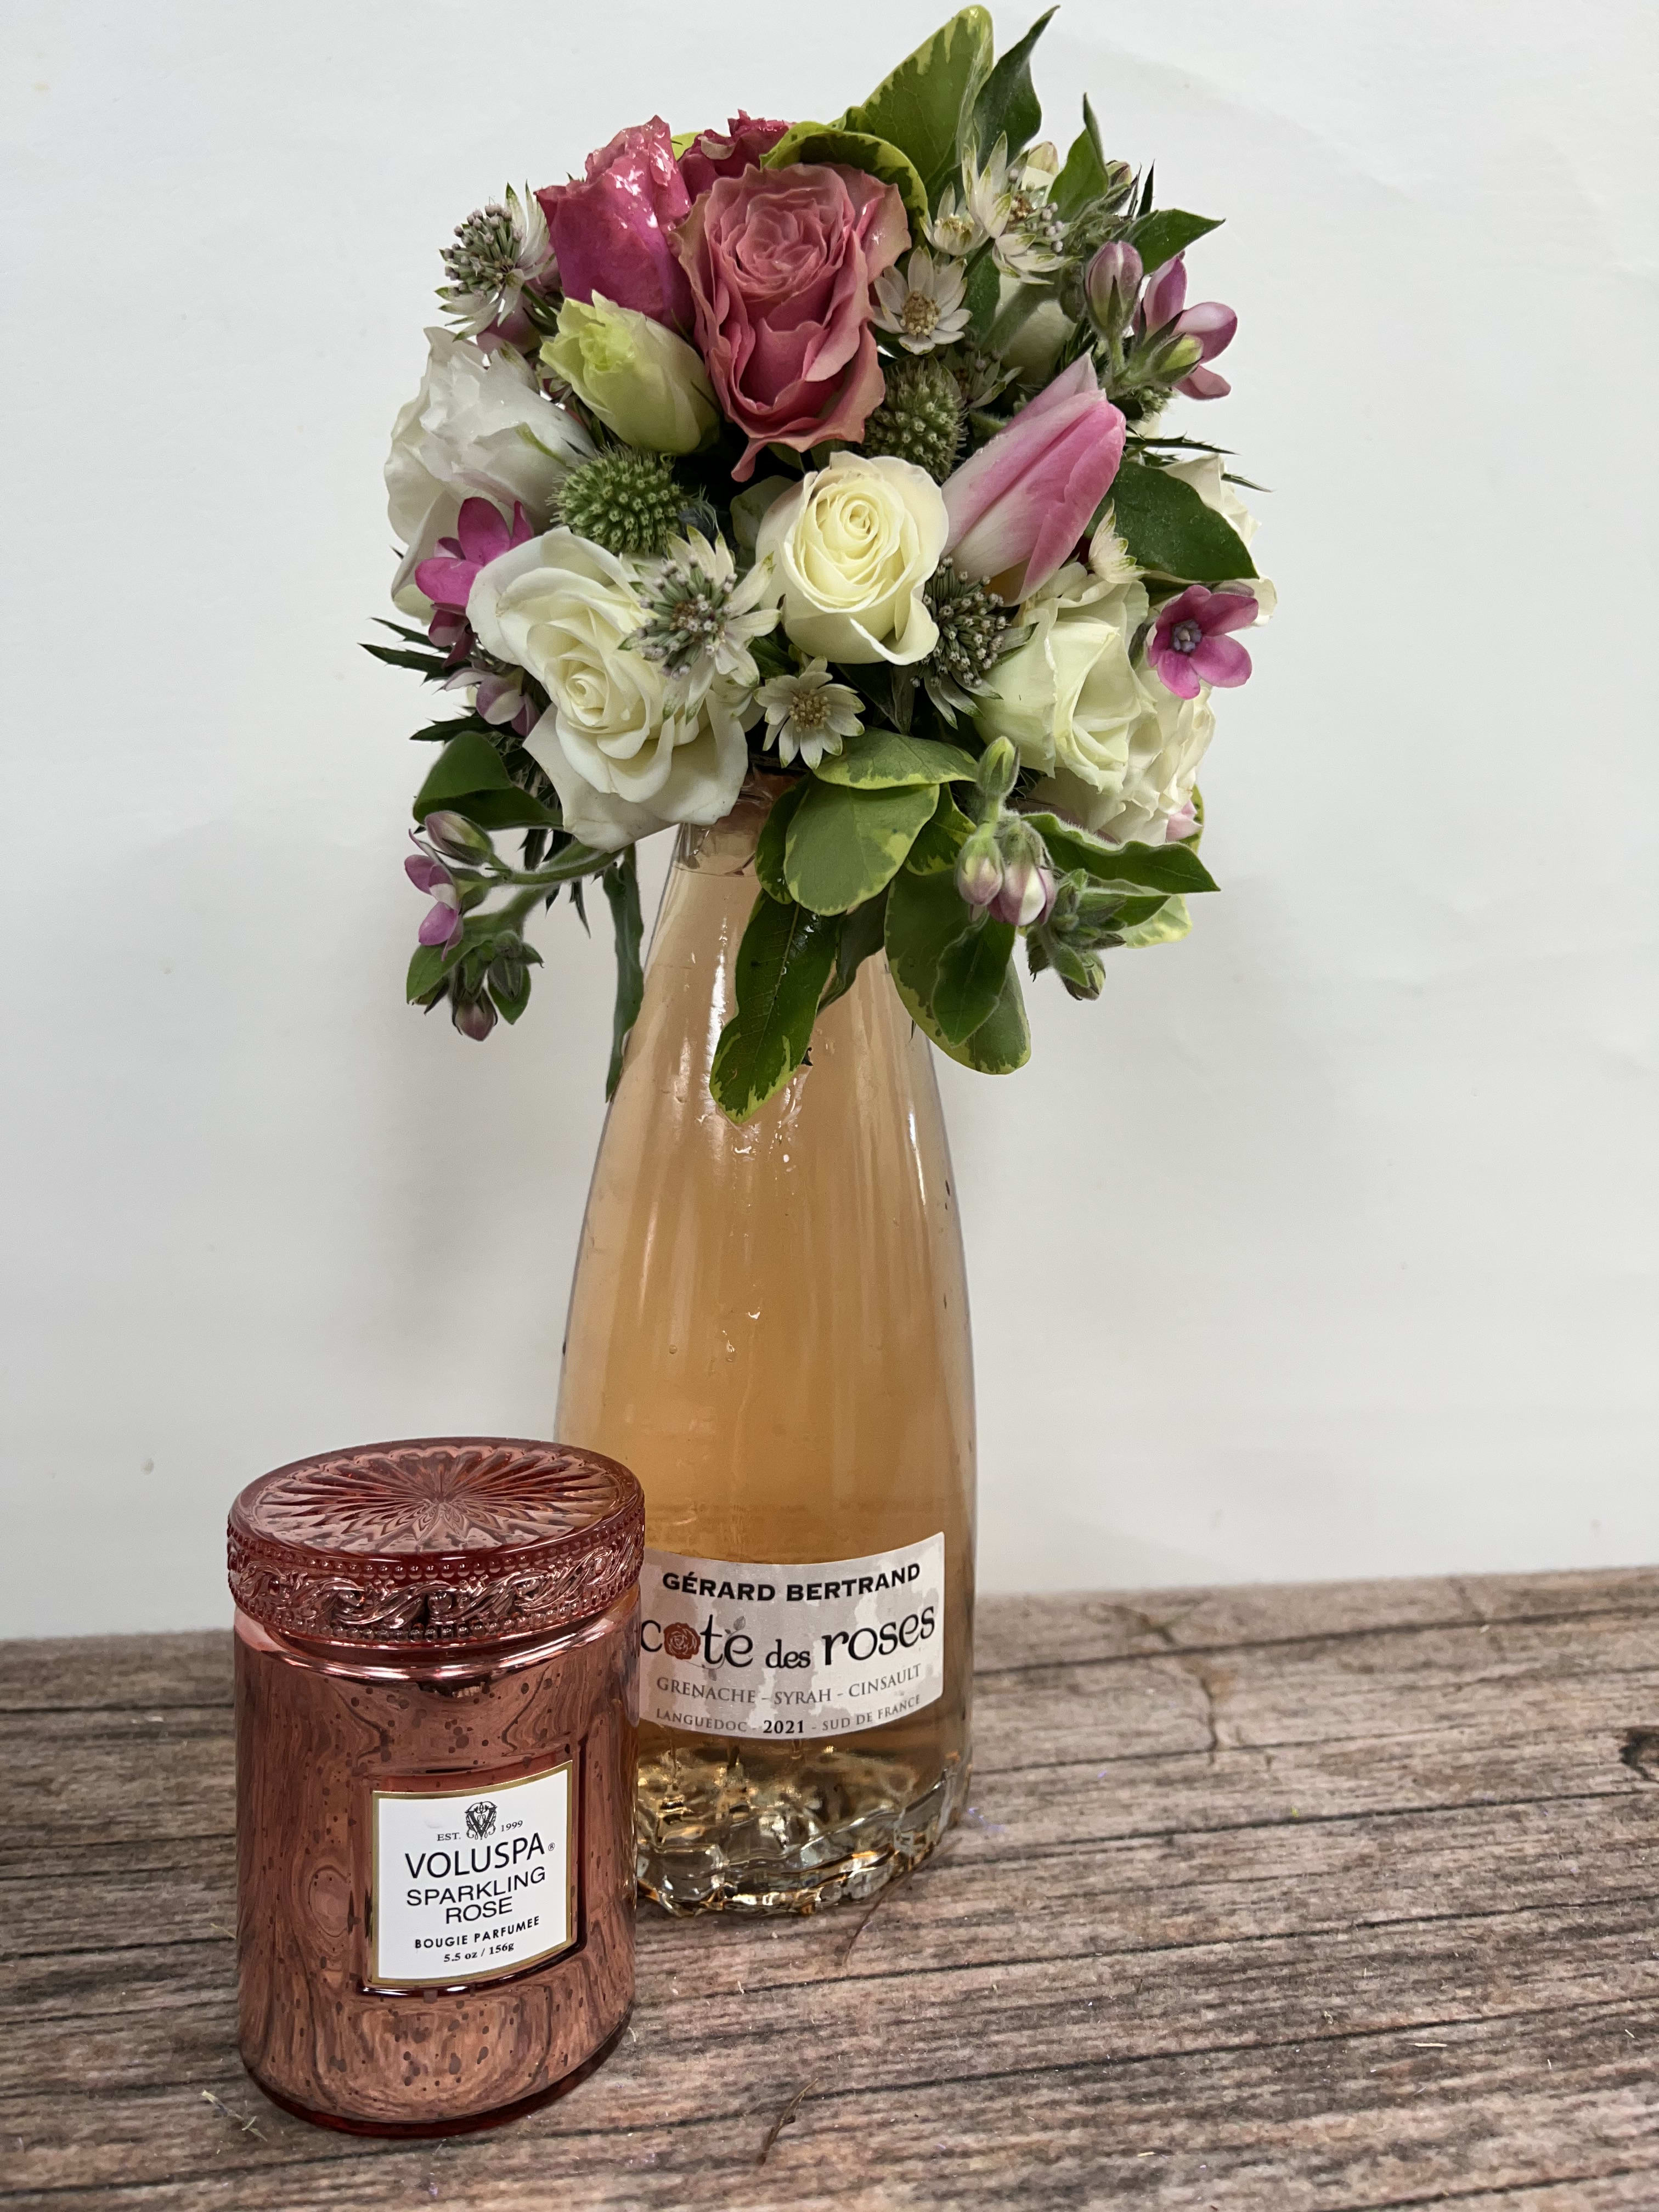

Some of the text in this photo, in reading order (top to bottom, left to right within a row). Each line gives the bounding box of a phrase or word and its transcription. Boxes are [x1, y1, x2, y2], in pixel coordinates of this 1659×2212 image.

[662, 1562, 921, 1602] GÉRARD BERTRAND
[765, 1639, 811, 1669] des
[823, 1605, 935, 1666] roses
[656, 1677, 756, 1703] GRENACHE
[774, 1688, 831, 1705] SYRAH
[849, 1663, 922, 1697] CINSAULT
[656, 1708, 747, 1732] LANGUEDOC
[763, 1720, 804, 1734] 2021
[822, 1717, 850, 1731] SUD
[856, 1711, 873, 1725] DE
[878, 1694, 920, 1719] FRANCE
[437, 1820, 523, 1841] EST. 1999
[407, 1866, 546, 1906] SPARKLING
[446, 1896, 513, 1924] ROSE
[415, 1916, 539, 1949] BOUGIE PARFUMEE
[443, 1953, 461, 1962] 5.5
[465, 1951, 478, 1960] oz
[489, 1942, 515, 1956] 156g
